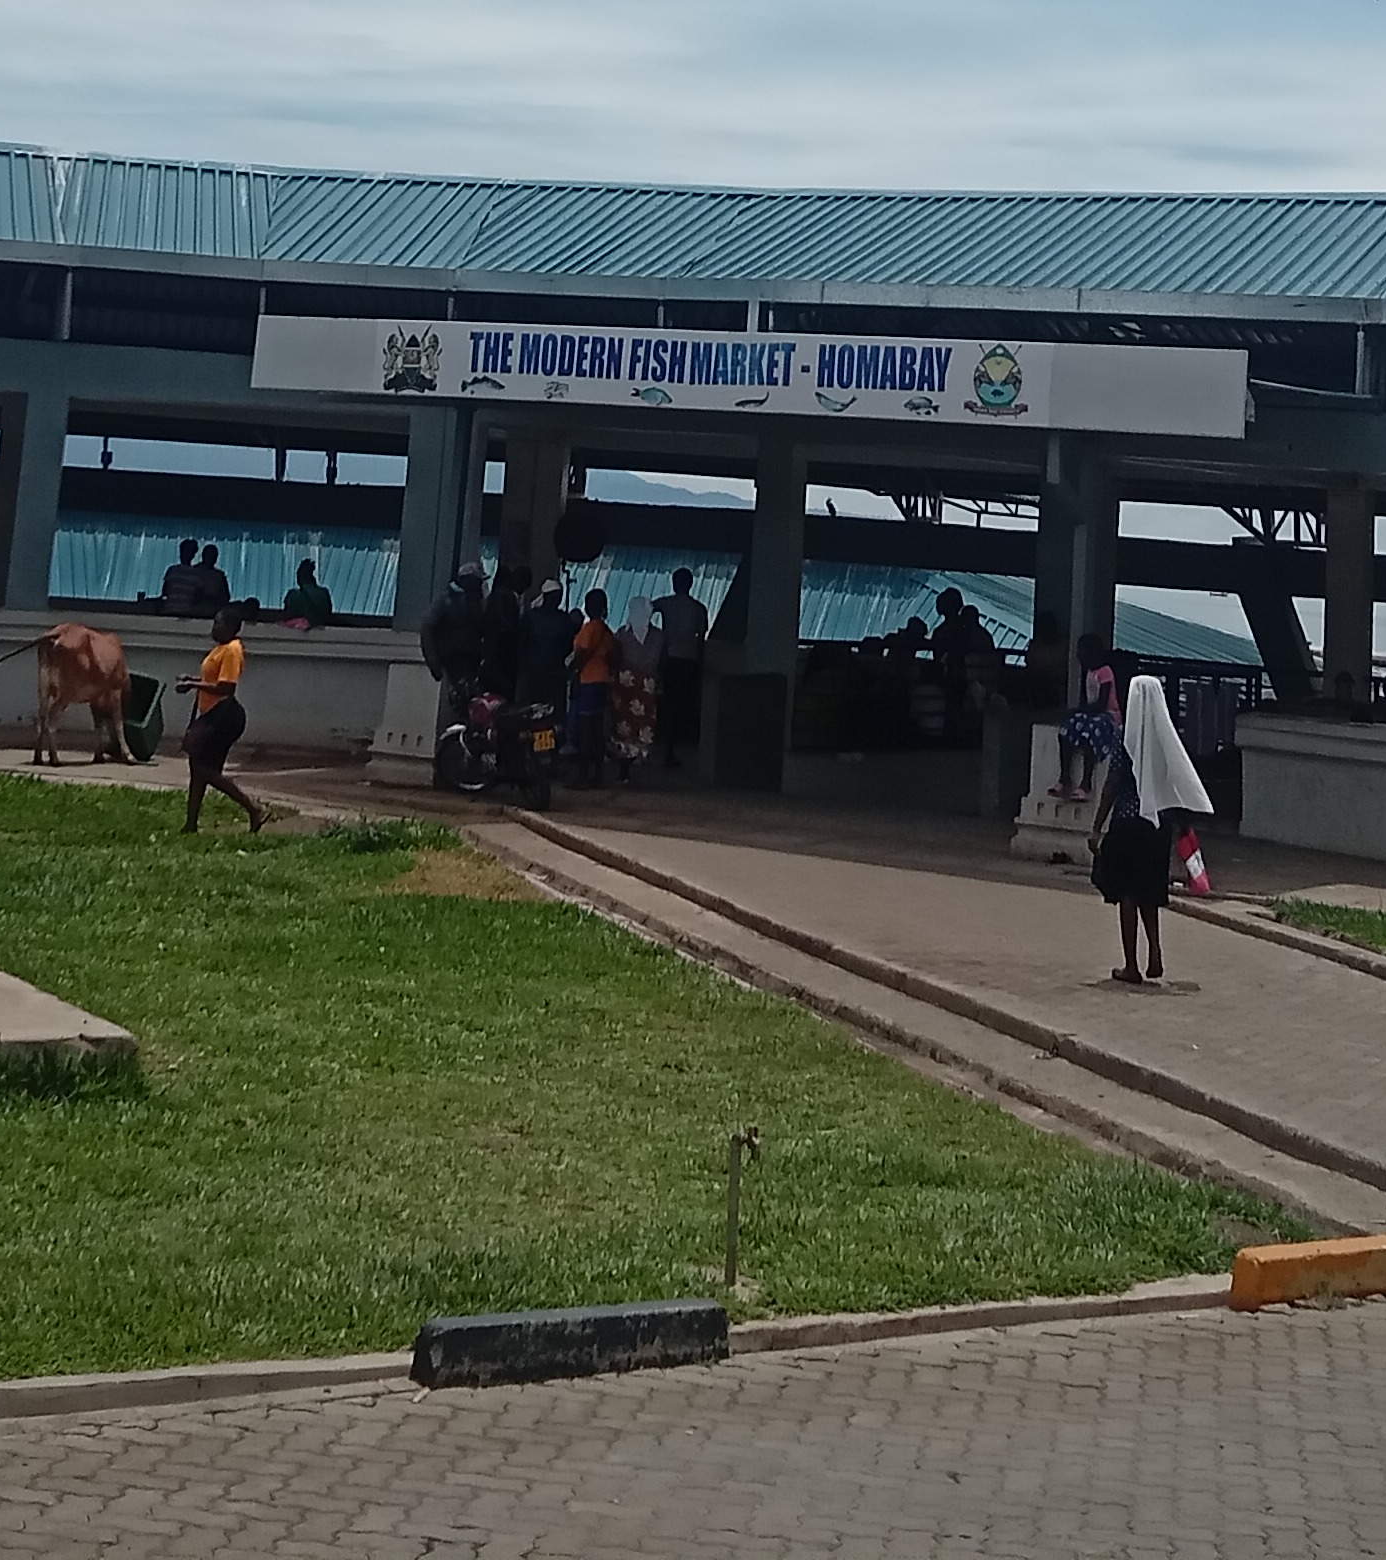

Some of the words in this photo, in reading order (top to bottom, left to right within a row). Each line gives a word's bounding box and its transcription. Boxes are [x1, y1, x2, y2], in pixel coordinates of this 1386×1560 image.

[470, 331, 514, 374] THE
[518, 332, 624, 380] MODERN
[628, 338, 687, 384] FISH
[689, 341, 796, 387] MARKET
[816, 343, 953, 392] HOMABAY
